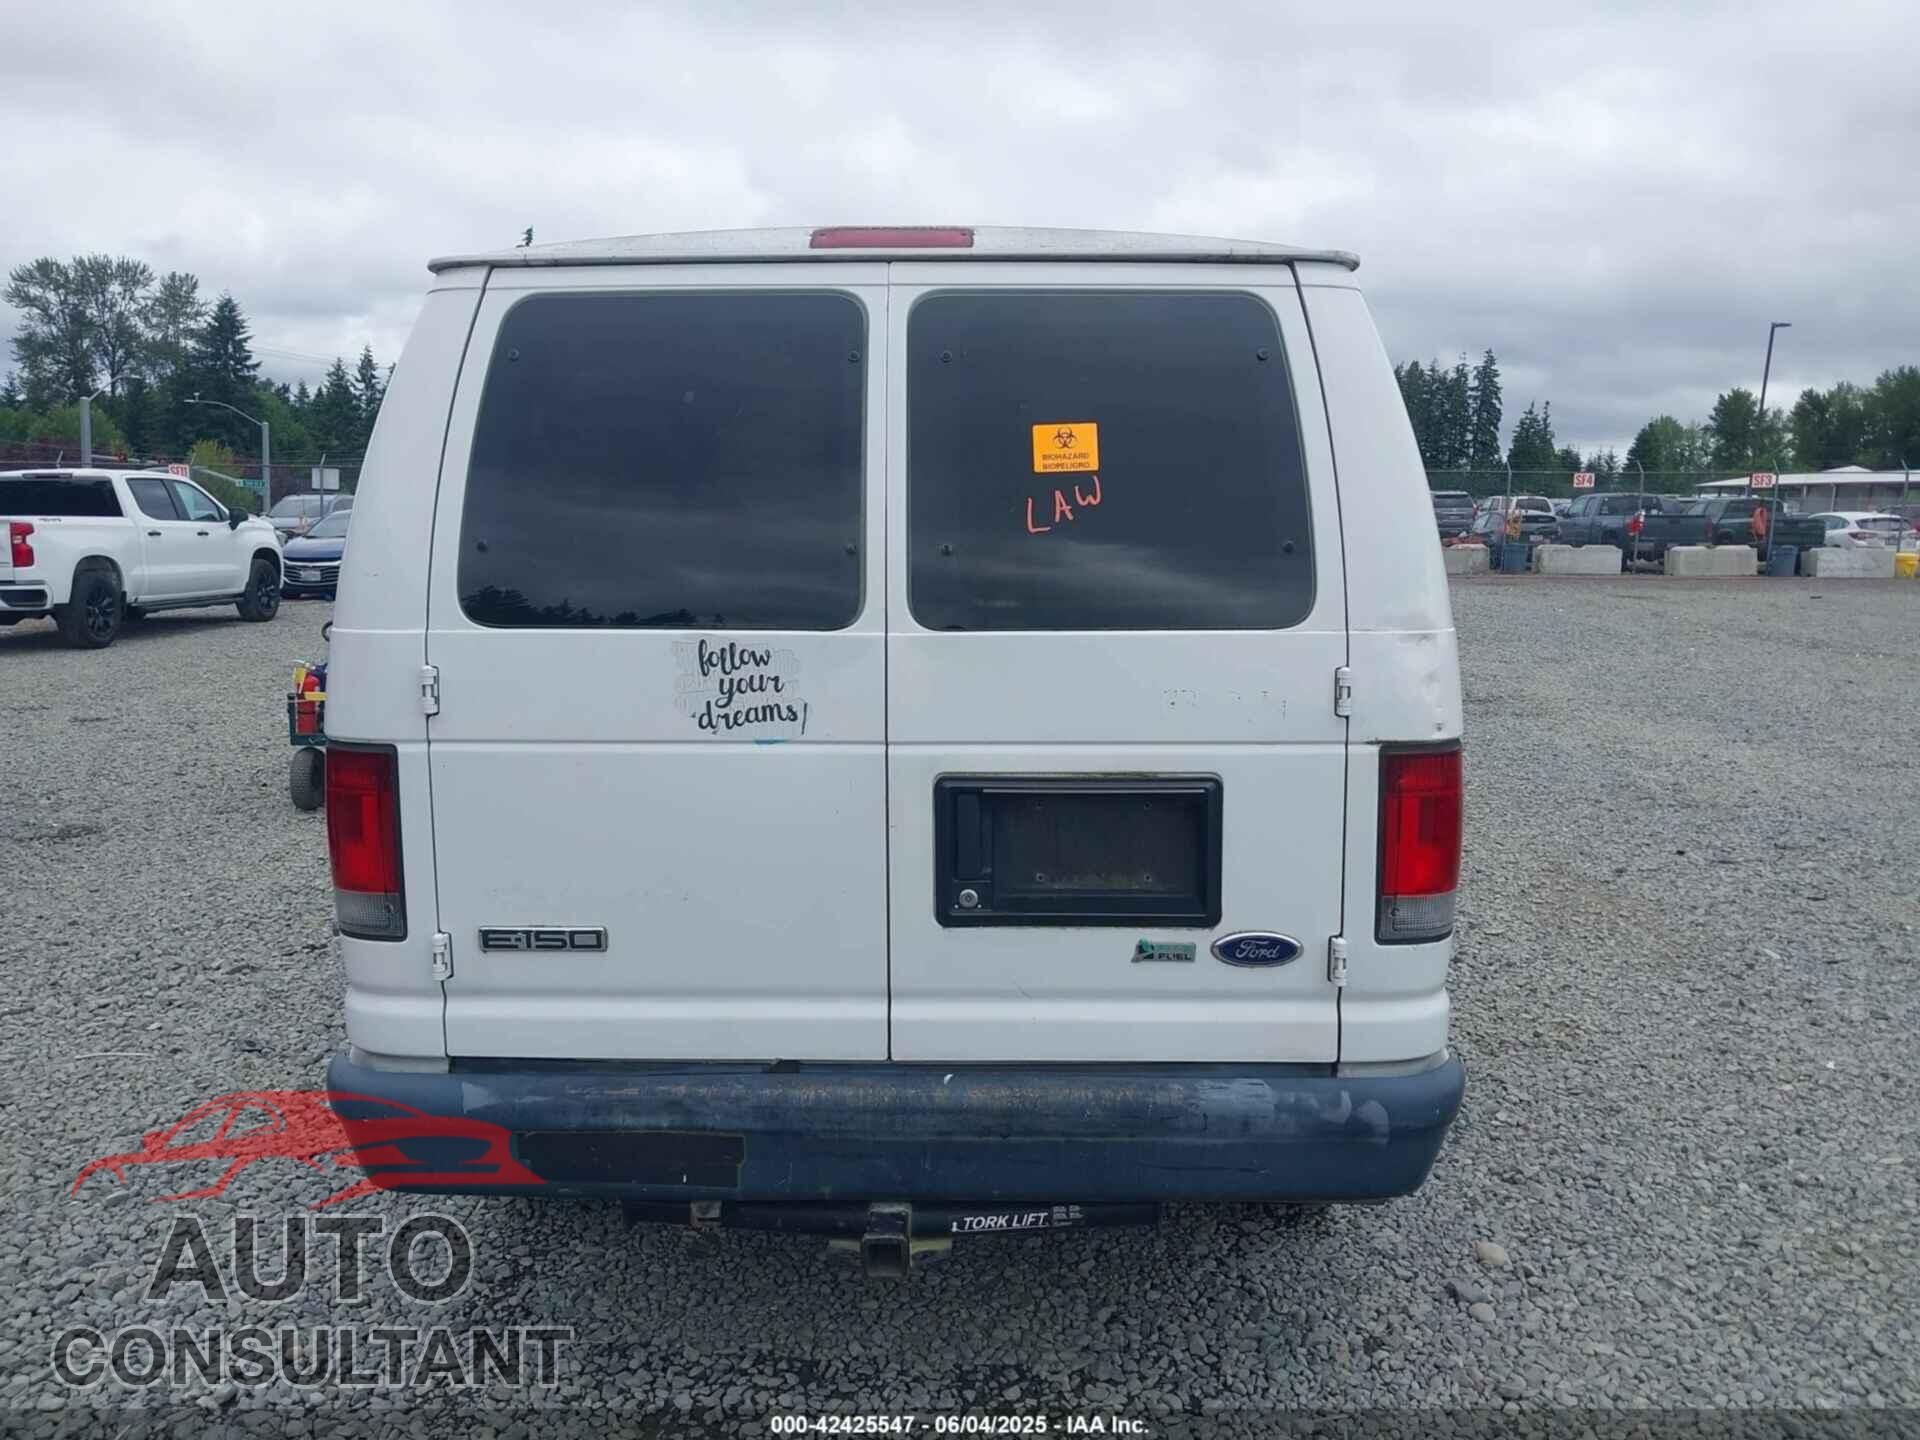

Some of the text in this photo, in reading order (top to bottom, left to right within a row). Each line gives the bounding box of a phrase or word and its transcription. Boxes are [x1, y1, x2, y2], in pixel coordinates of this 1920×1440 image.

[1575, 474, 1593, 486] SF4
[1753, 475, 1772, 486] SF3
[1027, 475, 1101, 533] LAW
[698, 639, 770, 677] follow
[715, 674, 784, 708] your
[1158, 953, 1192, 961] FUEL
[1234, 939, 1281, 959] Ford
[964, 1215, 1008, 1231] TORK
[1012, 1212, 1048, 1227] LIFT
